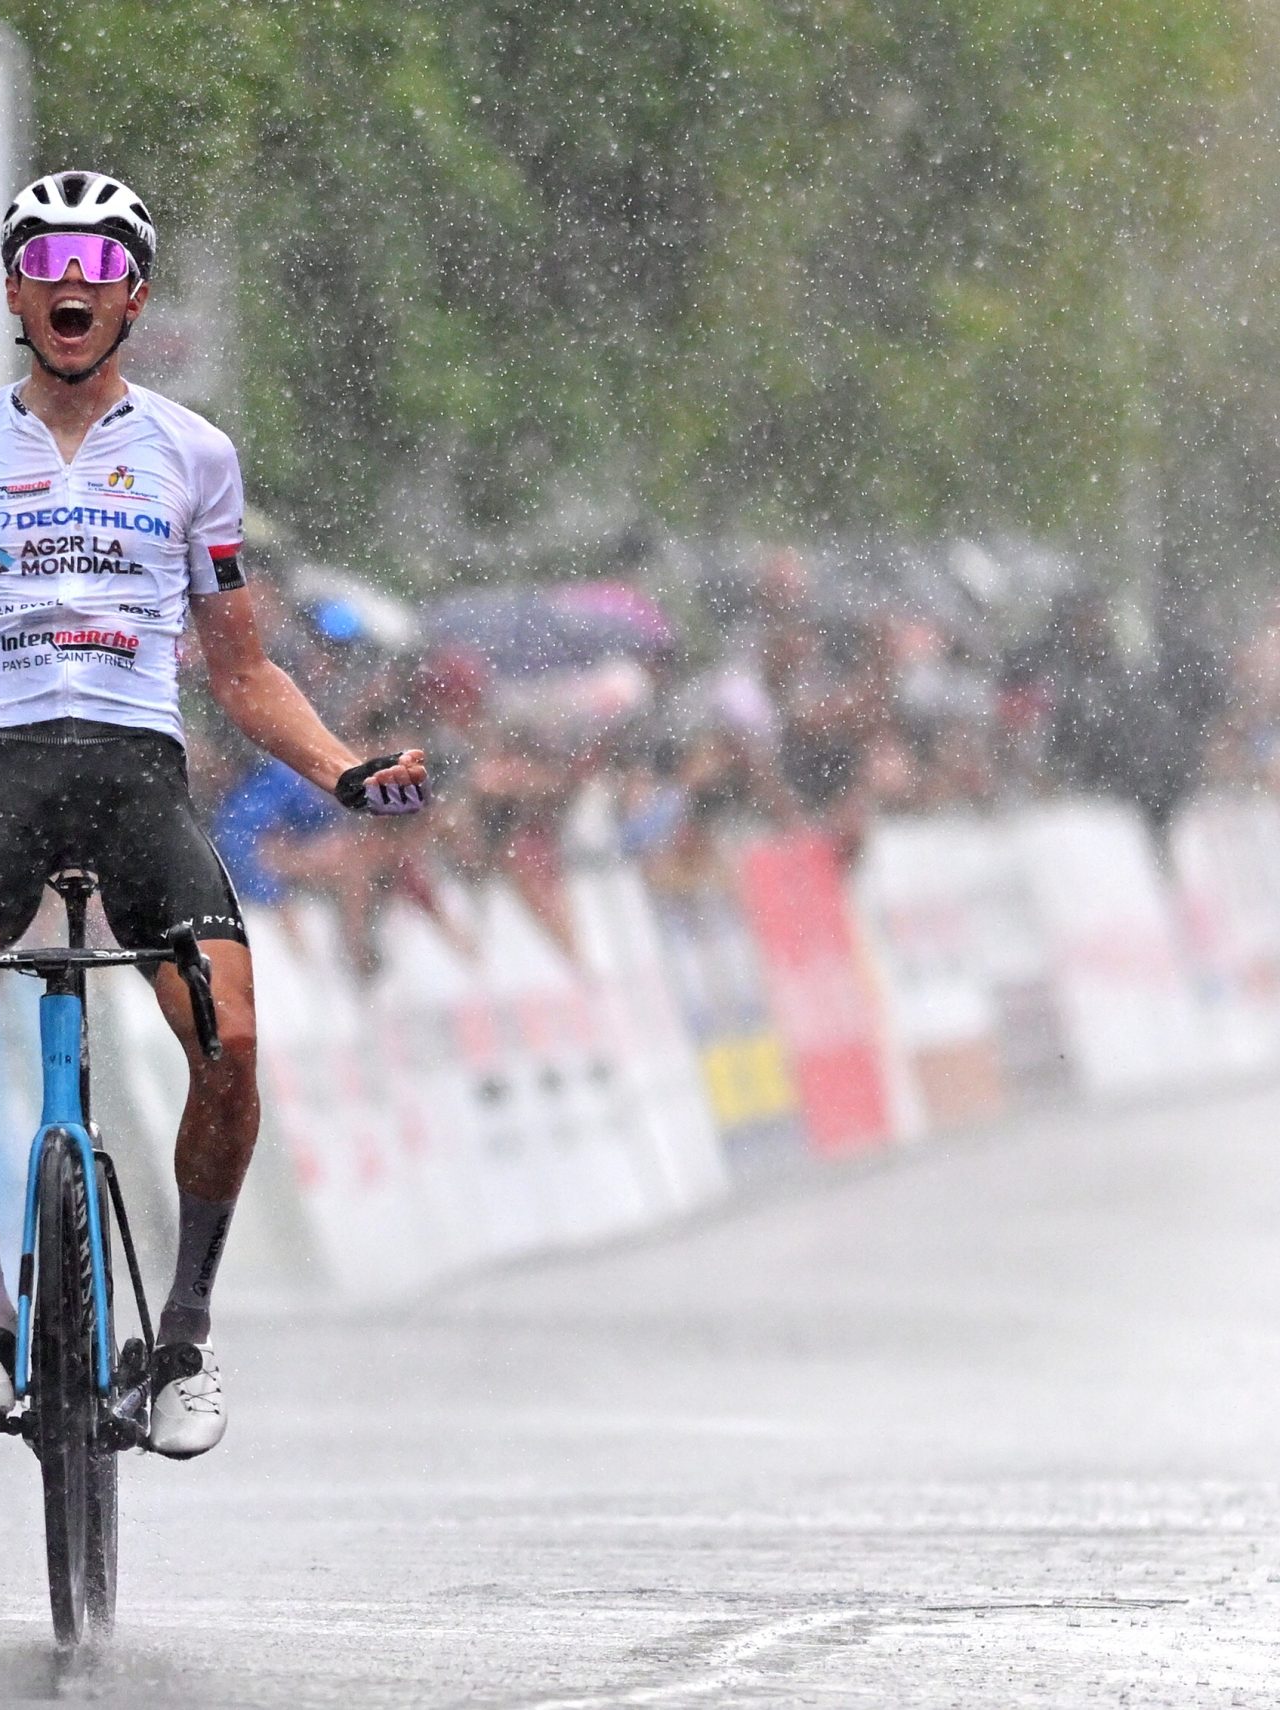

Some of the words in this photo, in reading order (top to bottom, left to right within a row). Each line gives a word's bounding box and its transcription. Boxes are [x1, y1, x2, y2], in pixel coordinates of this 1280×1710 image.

[16, 506, 170, 539] DECATHLON
[21, 536, 85, 558] AG2R
[93, 536, 124, 558] LA
[21, 556, 143, 576] MONDIALE
[1, 630, 140, 653] Intermarché
[2, 656, 32, 672] PAYS
[35, 653, 53, 666] DE
